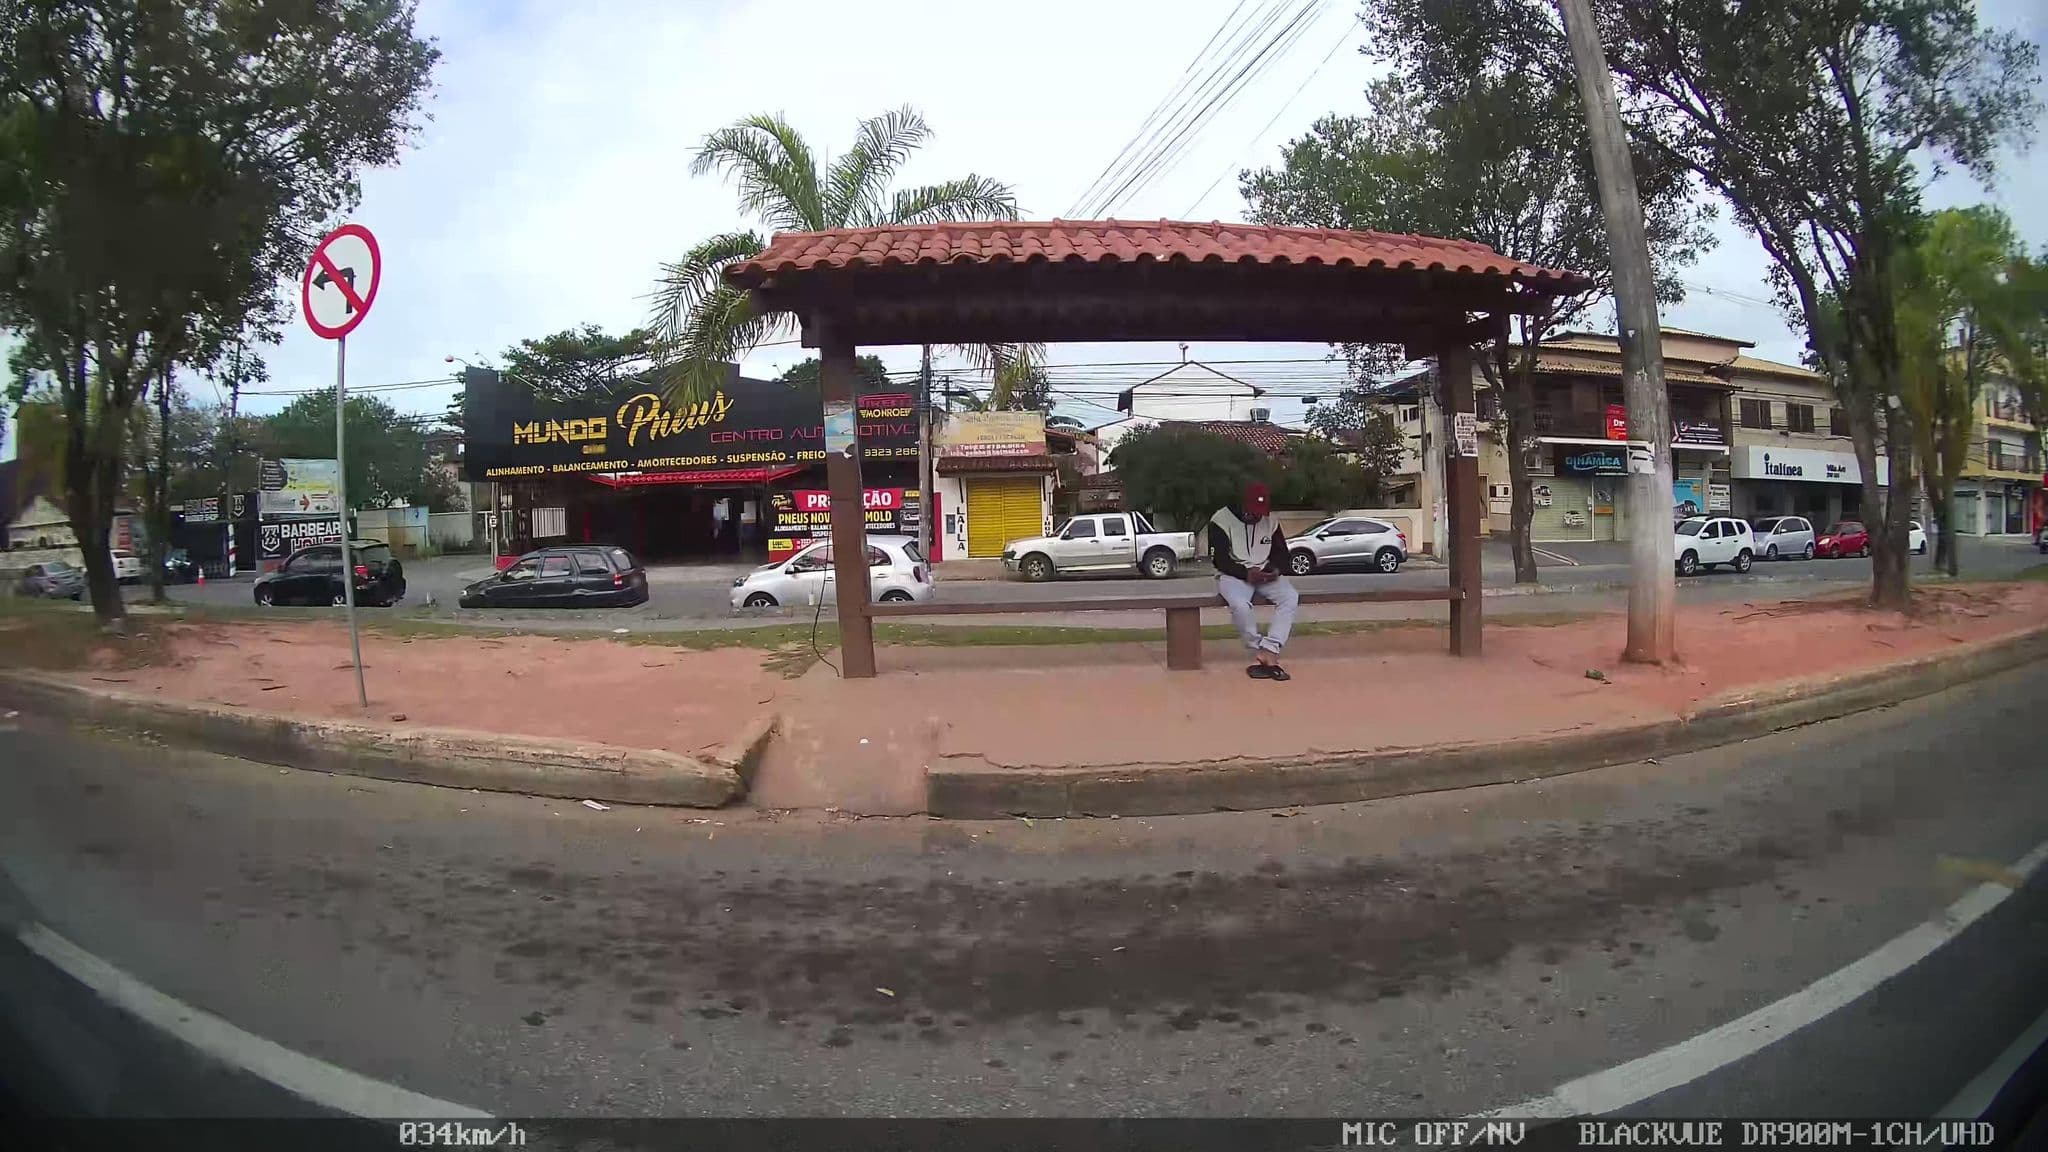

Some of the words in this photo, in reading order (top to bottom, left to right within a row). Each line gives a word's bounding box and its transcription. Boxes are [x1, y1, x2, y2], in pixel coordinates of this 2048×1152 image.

[513, 416, 607, 445] MUNDO
[616, 390, 734, 448] Pneus
[863, 408, 908, 418] MONROE
[710, 429, 783, 443] CENTRO
[486, 465, 545, 477] ALINHAMENTO
[553, 460, 628, 473] BALANCEAMENTO
[638, 455, 717, 468] AMORTECEDORES
[727, 450, 786, 463] SUSPENSÃO
[778, 512, 809, 524] PNEUS
[810, 512, 831, 523] NOV
[956, 506, 966, 551] LAILA
